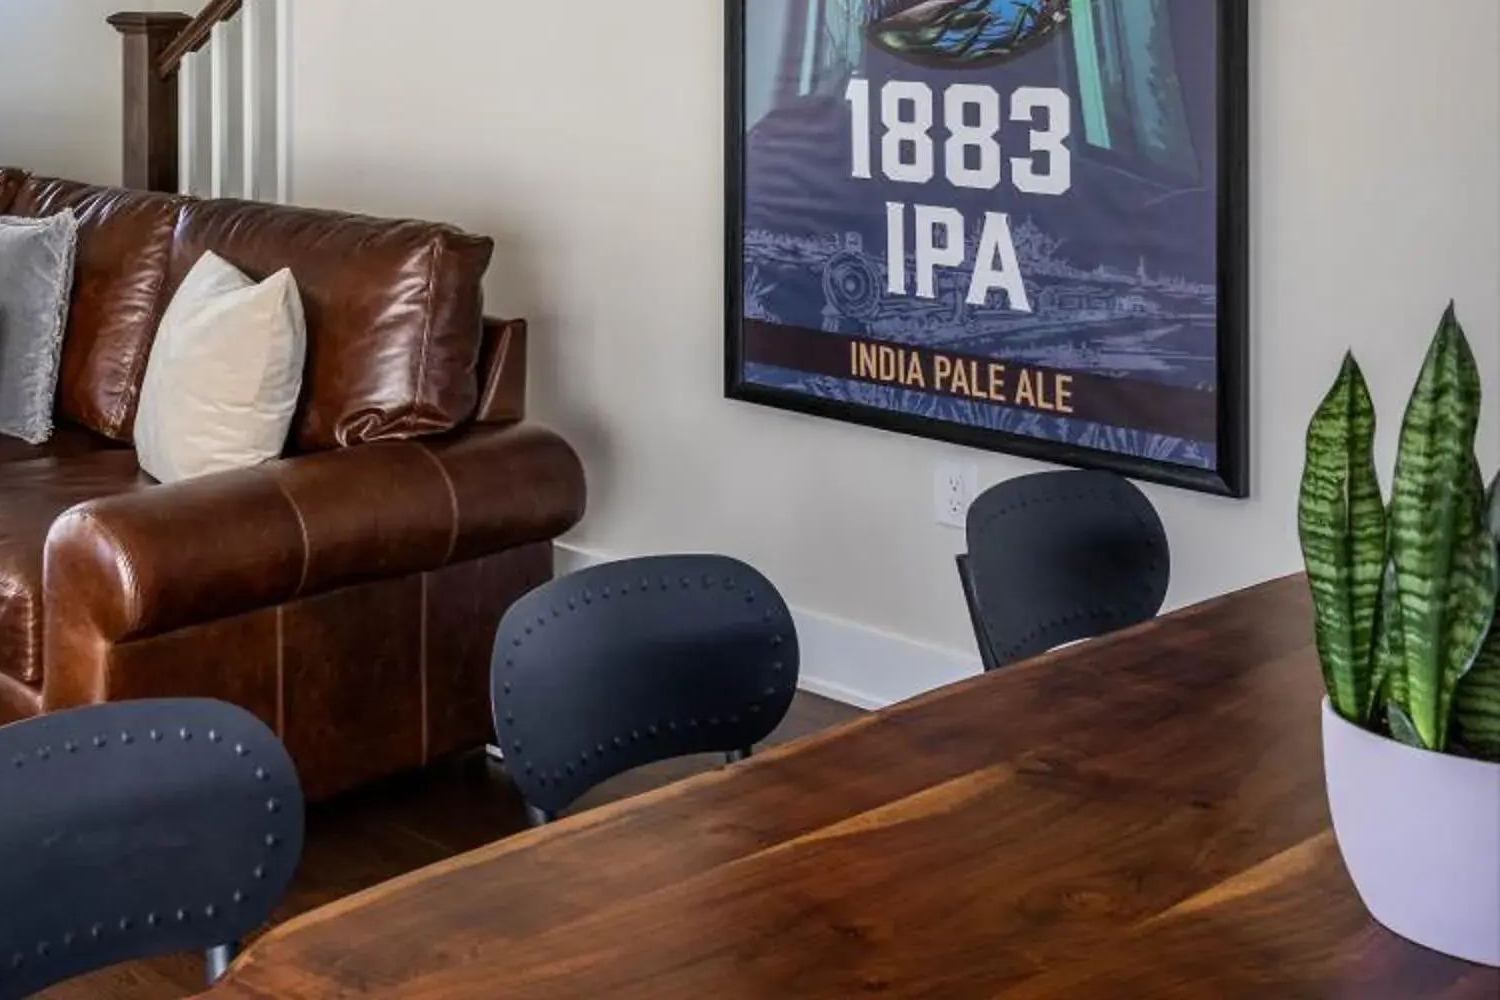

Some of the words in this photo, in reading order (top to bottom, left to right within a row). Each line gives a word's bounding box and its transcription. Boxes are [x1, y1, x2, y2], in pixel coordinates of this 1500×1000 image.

[845, 78, 1071, 195] 1883
[886, 202, 1032, 312] IPA
[850, 341, 924, 388] INDIA
[935, 357, 1005, 401] PALE
[1015, 371, 1073, 413] ALE
